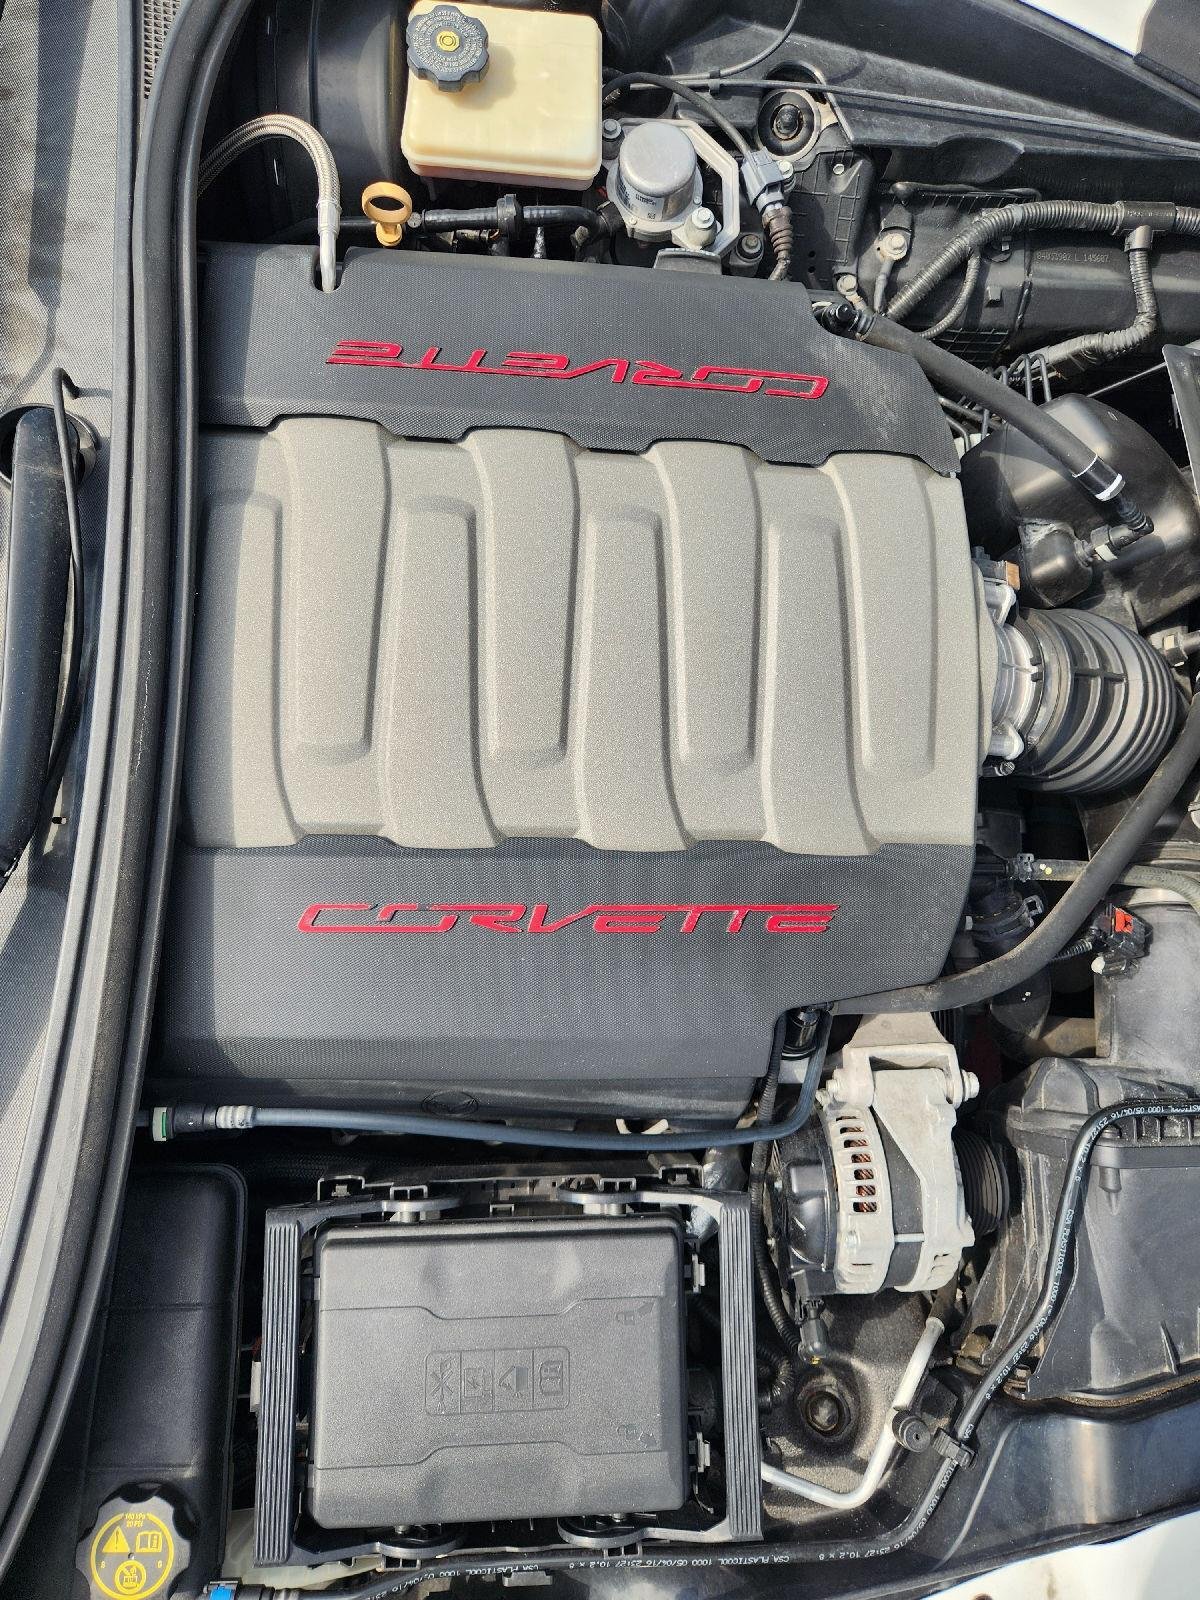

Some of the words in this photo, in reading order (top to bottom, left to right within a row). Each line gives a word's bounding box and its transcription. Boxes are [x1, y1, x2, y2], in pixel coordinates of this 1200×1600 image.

[325, 340, 829, 400] CORVETTE
[296, 902, 840, 934] CORVETTE
[1147, 1105, 1165, 1114] 1000
[691, 1558, 713, 1567] 1000
[718, 1556, 770, 1566] PLASTICOOL
[773, 1555, 790, 1563] CSA
